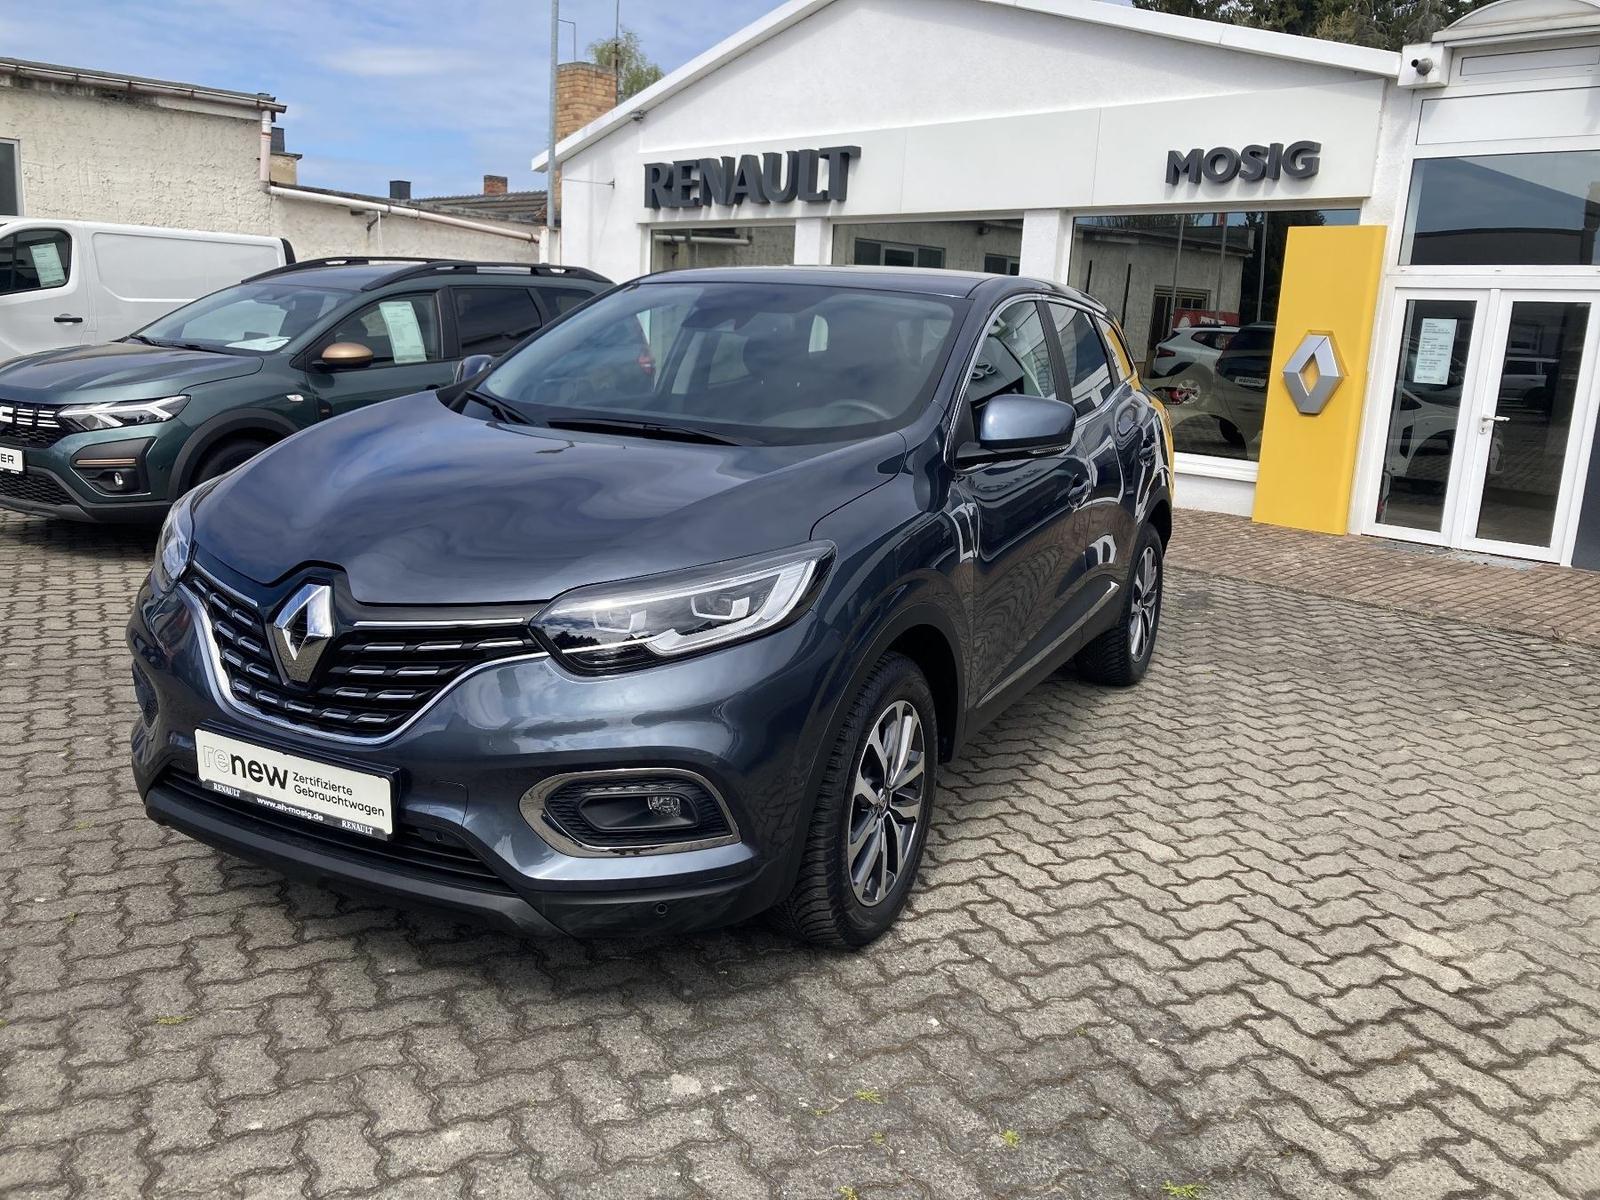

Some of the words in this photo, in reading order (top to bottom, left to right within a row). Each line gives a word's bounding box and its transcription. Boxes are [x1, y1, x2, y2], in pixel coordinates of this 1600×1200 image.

[644, 145, 861, 208] RENAULT
[1165, 140, 1322, 186] MOSIG
[203, 745, 288, 790] renew
[212, 782, 241, 798] RENAULT
[292, 771, 353, 796] Zertifizierte
[256, 797, 324, 821] www.ah-mosig.de
[294, 784, 385, 817] Gebrauchtwagen
[341, 820, 374, 835] RENAULT
